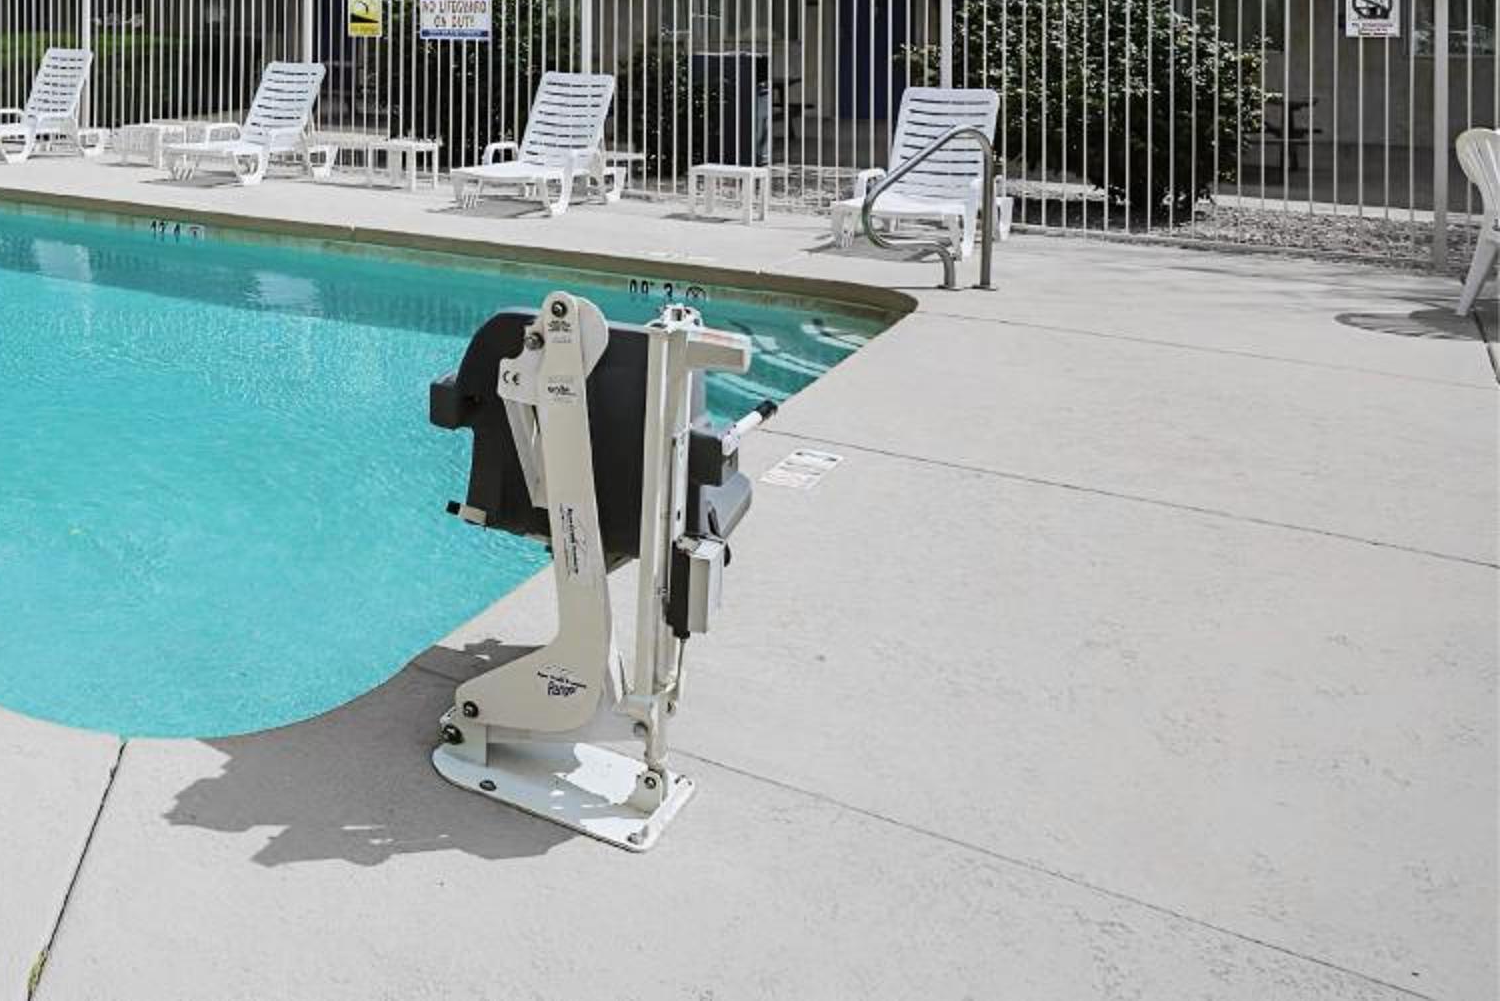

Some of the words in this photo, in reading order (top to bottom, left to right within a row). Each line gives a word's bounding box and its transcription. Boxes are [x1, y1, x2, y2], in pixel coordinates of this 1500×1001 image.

[422, 0, 436, 14] NO
[439, 0, 486, 14] LIFEGUARD
[433, 15, 446, 28] ON
[451, 15, 475, 28] DUTY
